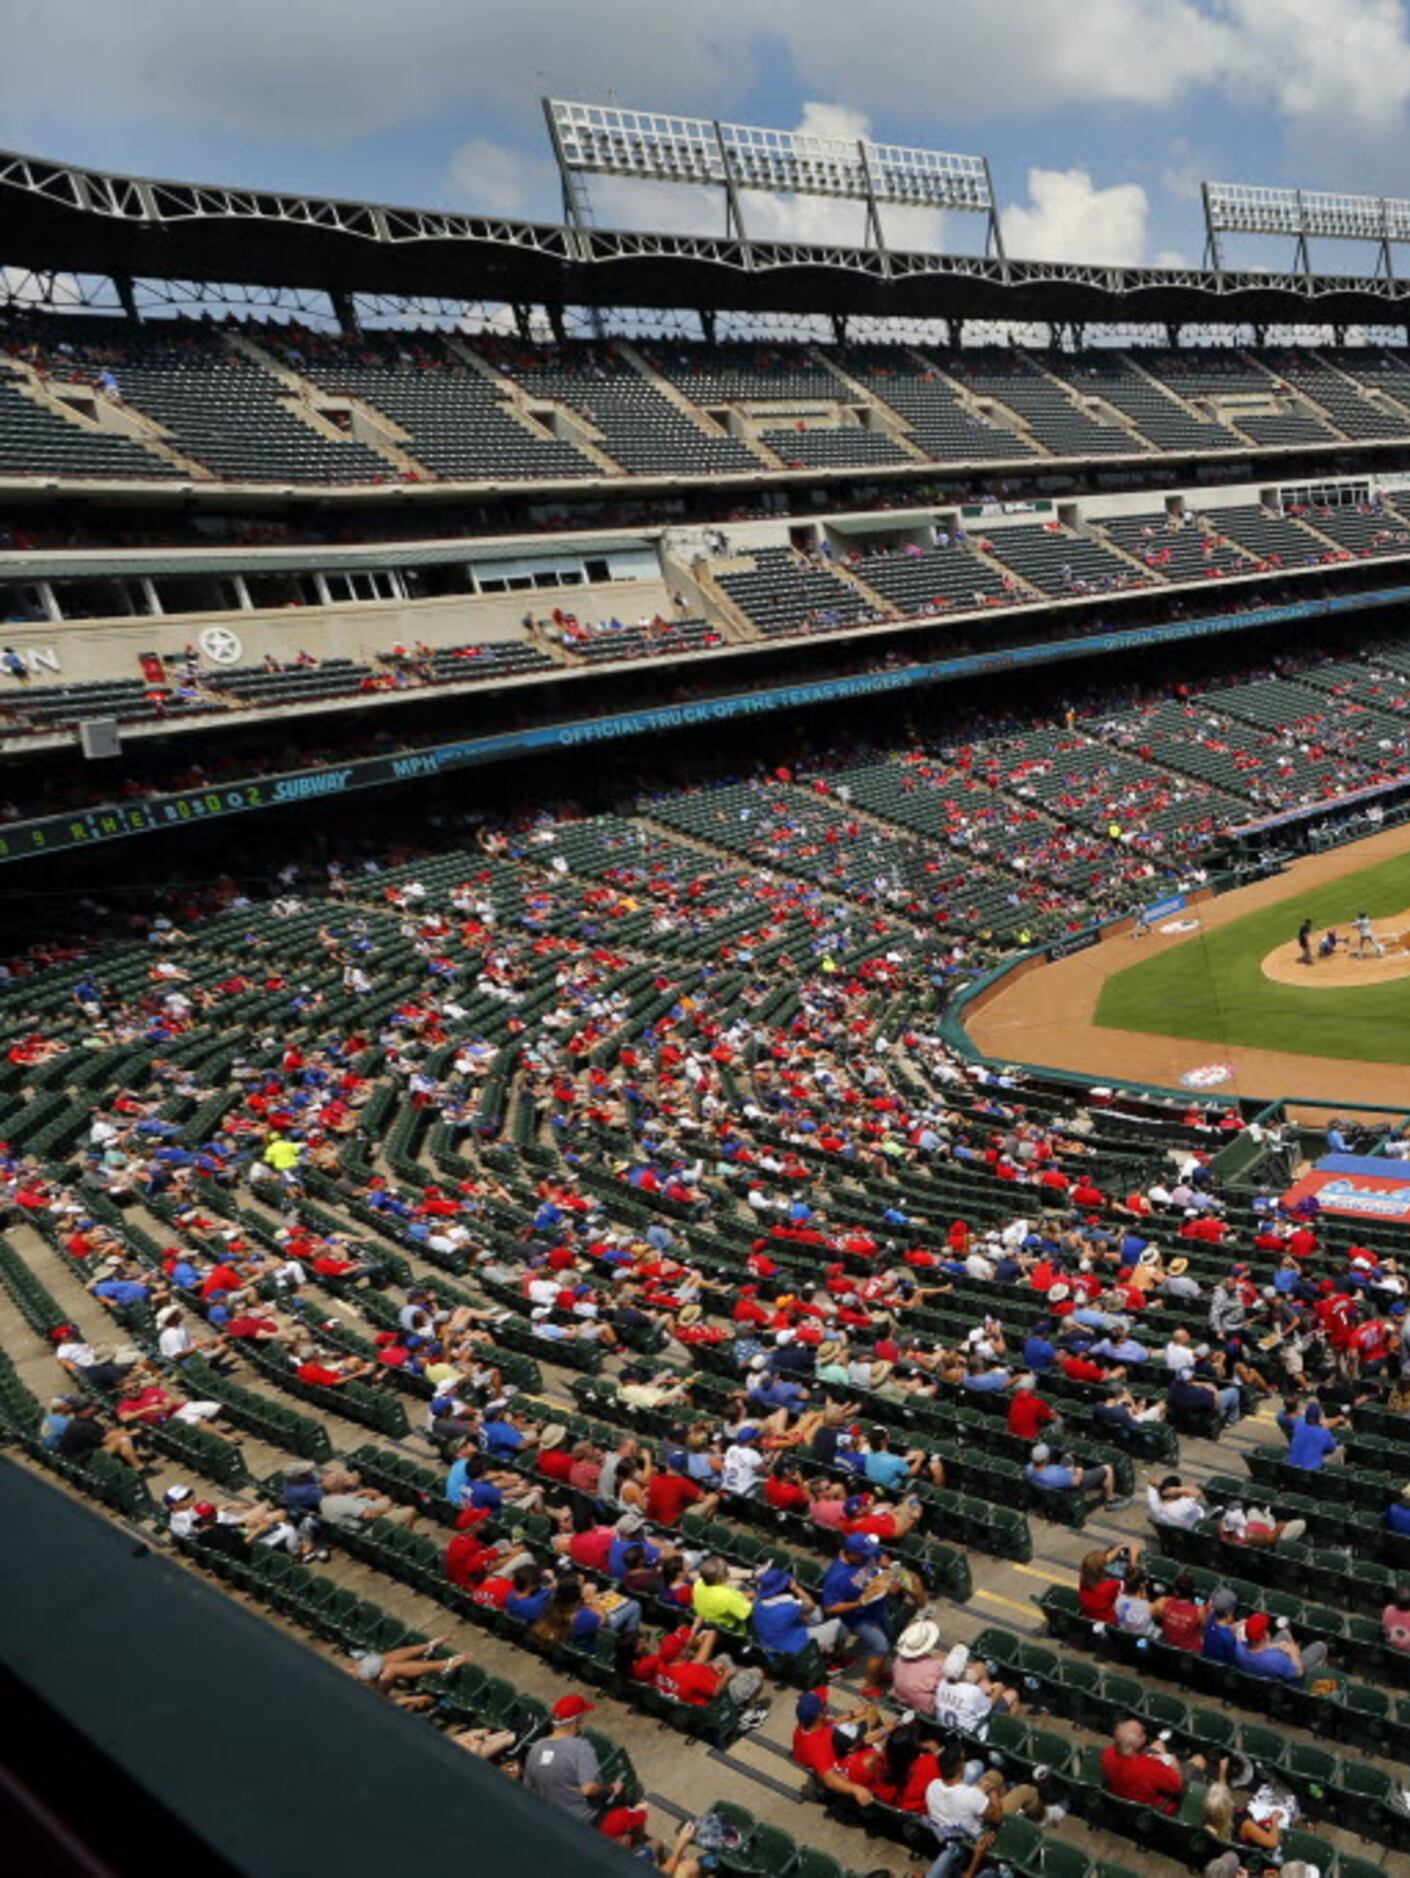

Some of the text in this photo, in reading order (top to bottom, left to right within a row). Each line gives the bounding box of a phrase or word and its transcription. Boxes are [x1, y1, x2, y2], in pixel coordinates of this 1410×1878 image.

[557, 672, 913, 745] OFFICIAL TRUCK OF THE TEXAS RANGERS
[391, 753, 439, 778] MPH
[271, 770, 353, 801] SUBWAY
